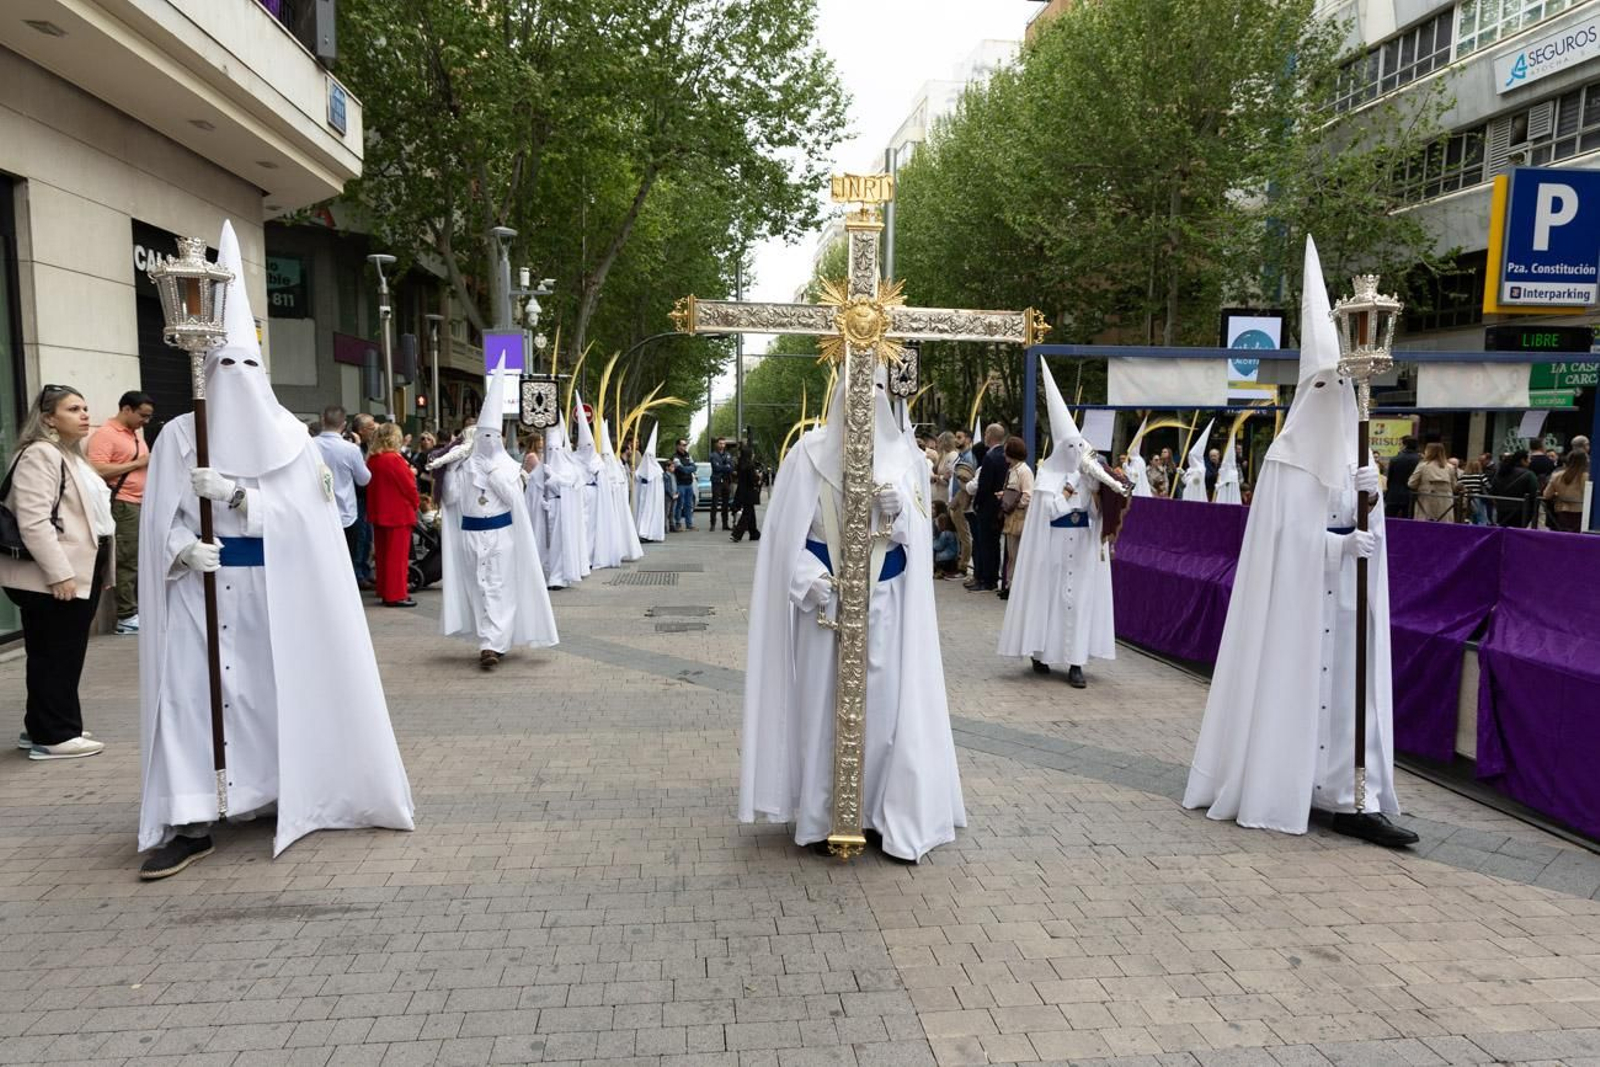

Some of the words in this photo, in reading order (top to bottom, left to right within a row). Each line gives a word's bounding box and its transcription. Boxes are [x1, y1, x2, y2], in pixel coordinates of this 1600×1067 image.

[1533, 183, 1579, 251] P
[1507, 262, 1528, 273] Pza.
[1531, 263, 1596, 275] Constitución
[1523, 288, 1590, 301] Interparking
[1522, 333, 1559, 347] LIBRE
[1551, 363, 1567, 374] LA
[1565, 373, 1598, 385] CARC
